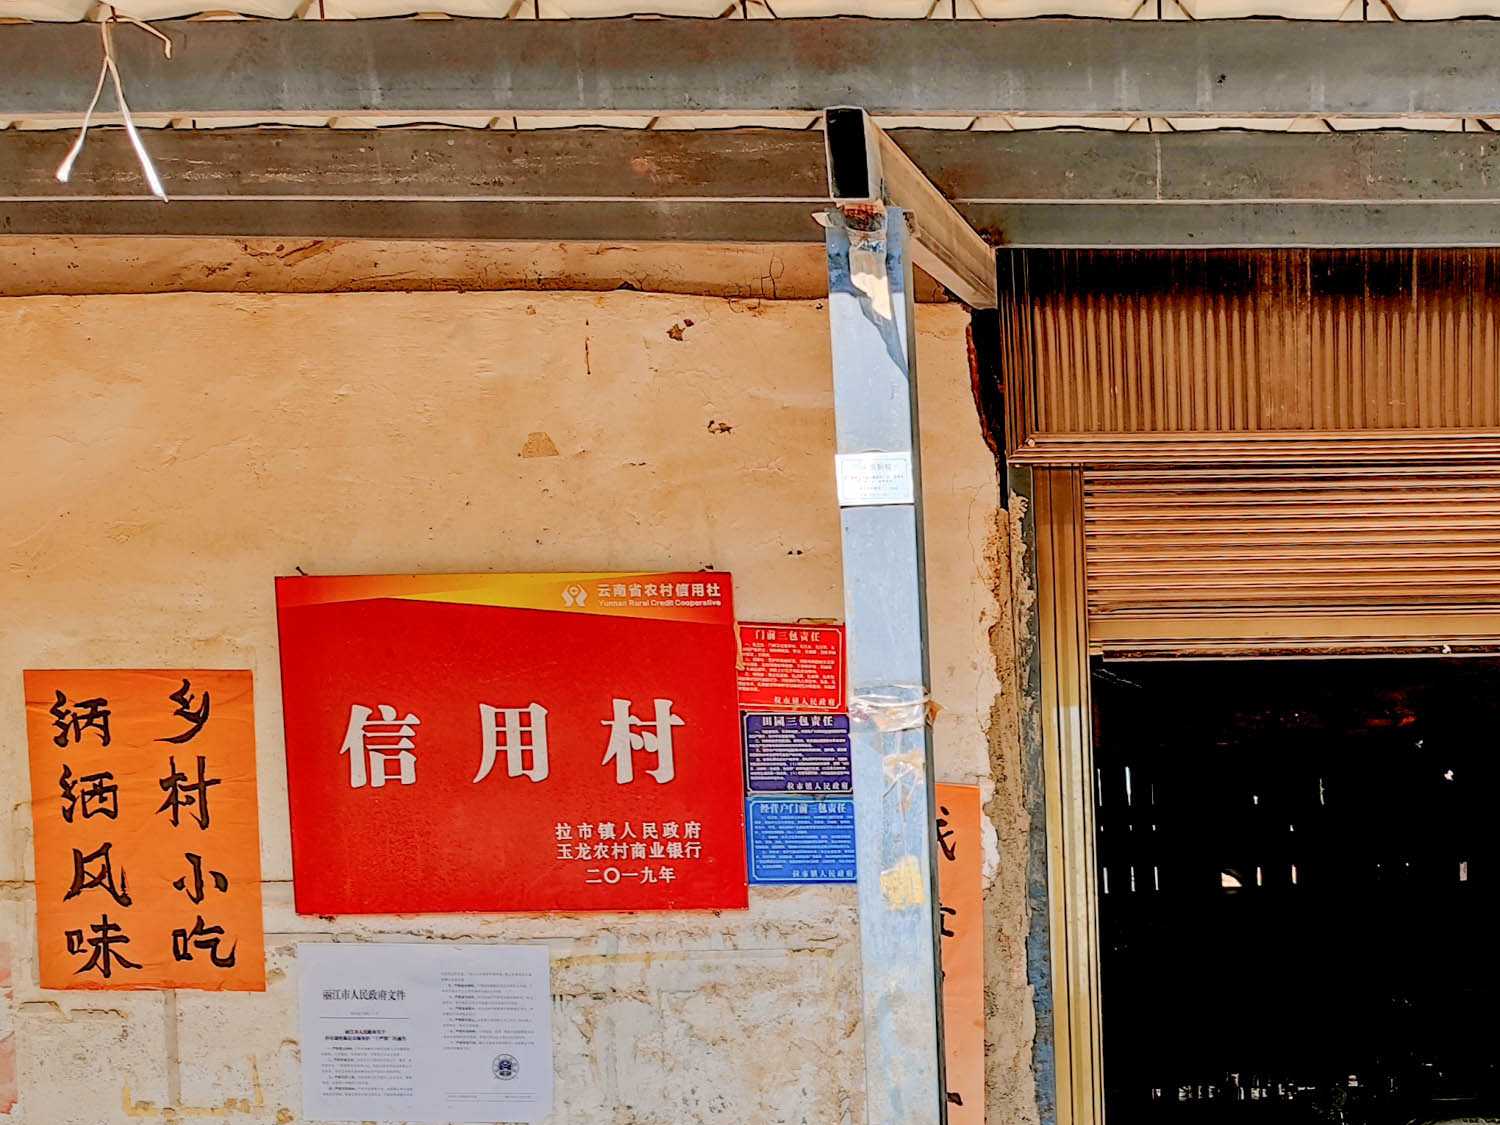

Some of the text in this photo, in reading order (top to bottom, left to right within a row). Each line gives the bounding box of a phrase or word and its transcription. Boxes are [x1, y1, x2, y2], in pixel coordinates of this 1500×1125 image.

[597, 583, 721, 598] 云南省农村信用社
[598, 599, 722, 608] Yunnan Rural Credit Cooperative
[340, 697, 686, 788] 信用村
[152, 678, 238, 968] 乡村小吃
[555, 821, 702, 840] 拉市镇人民政府
[557, 841, 702, 860] 玉龙农村商业银行
[322, 989, 406, 1001] 丽江市人民政府文件
